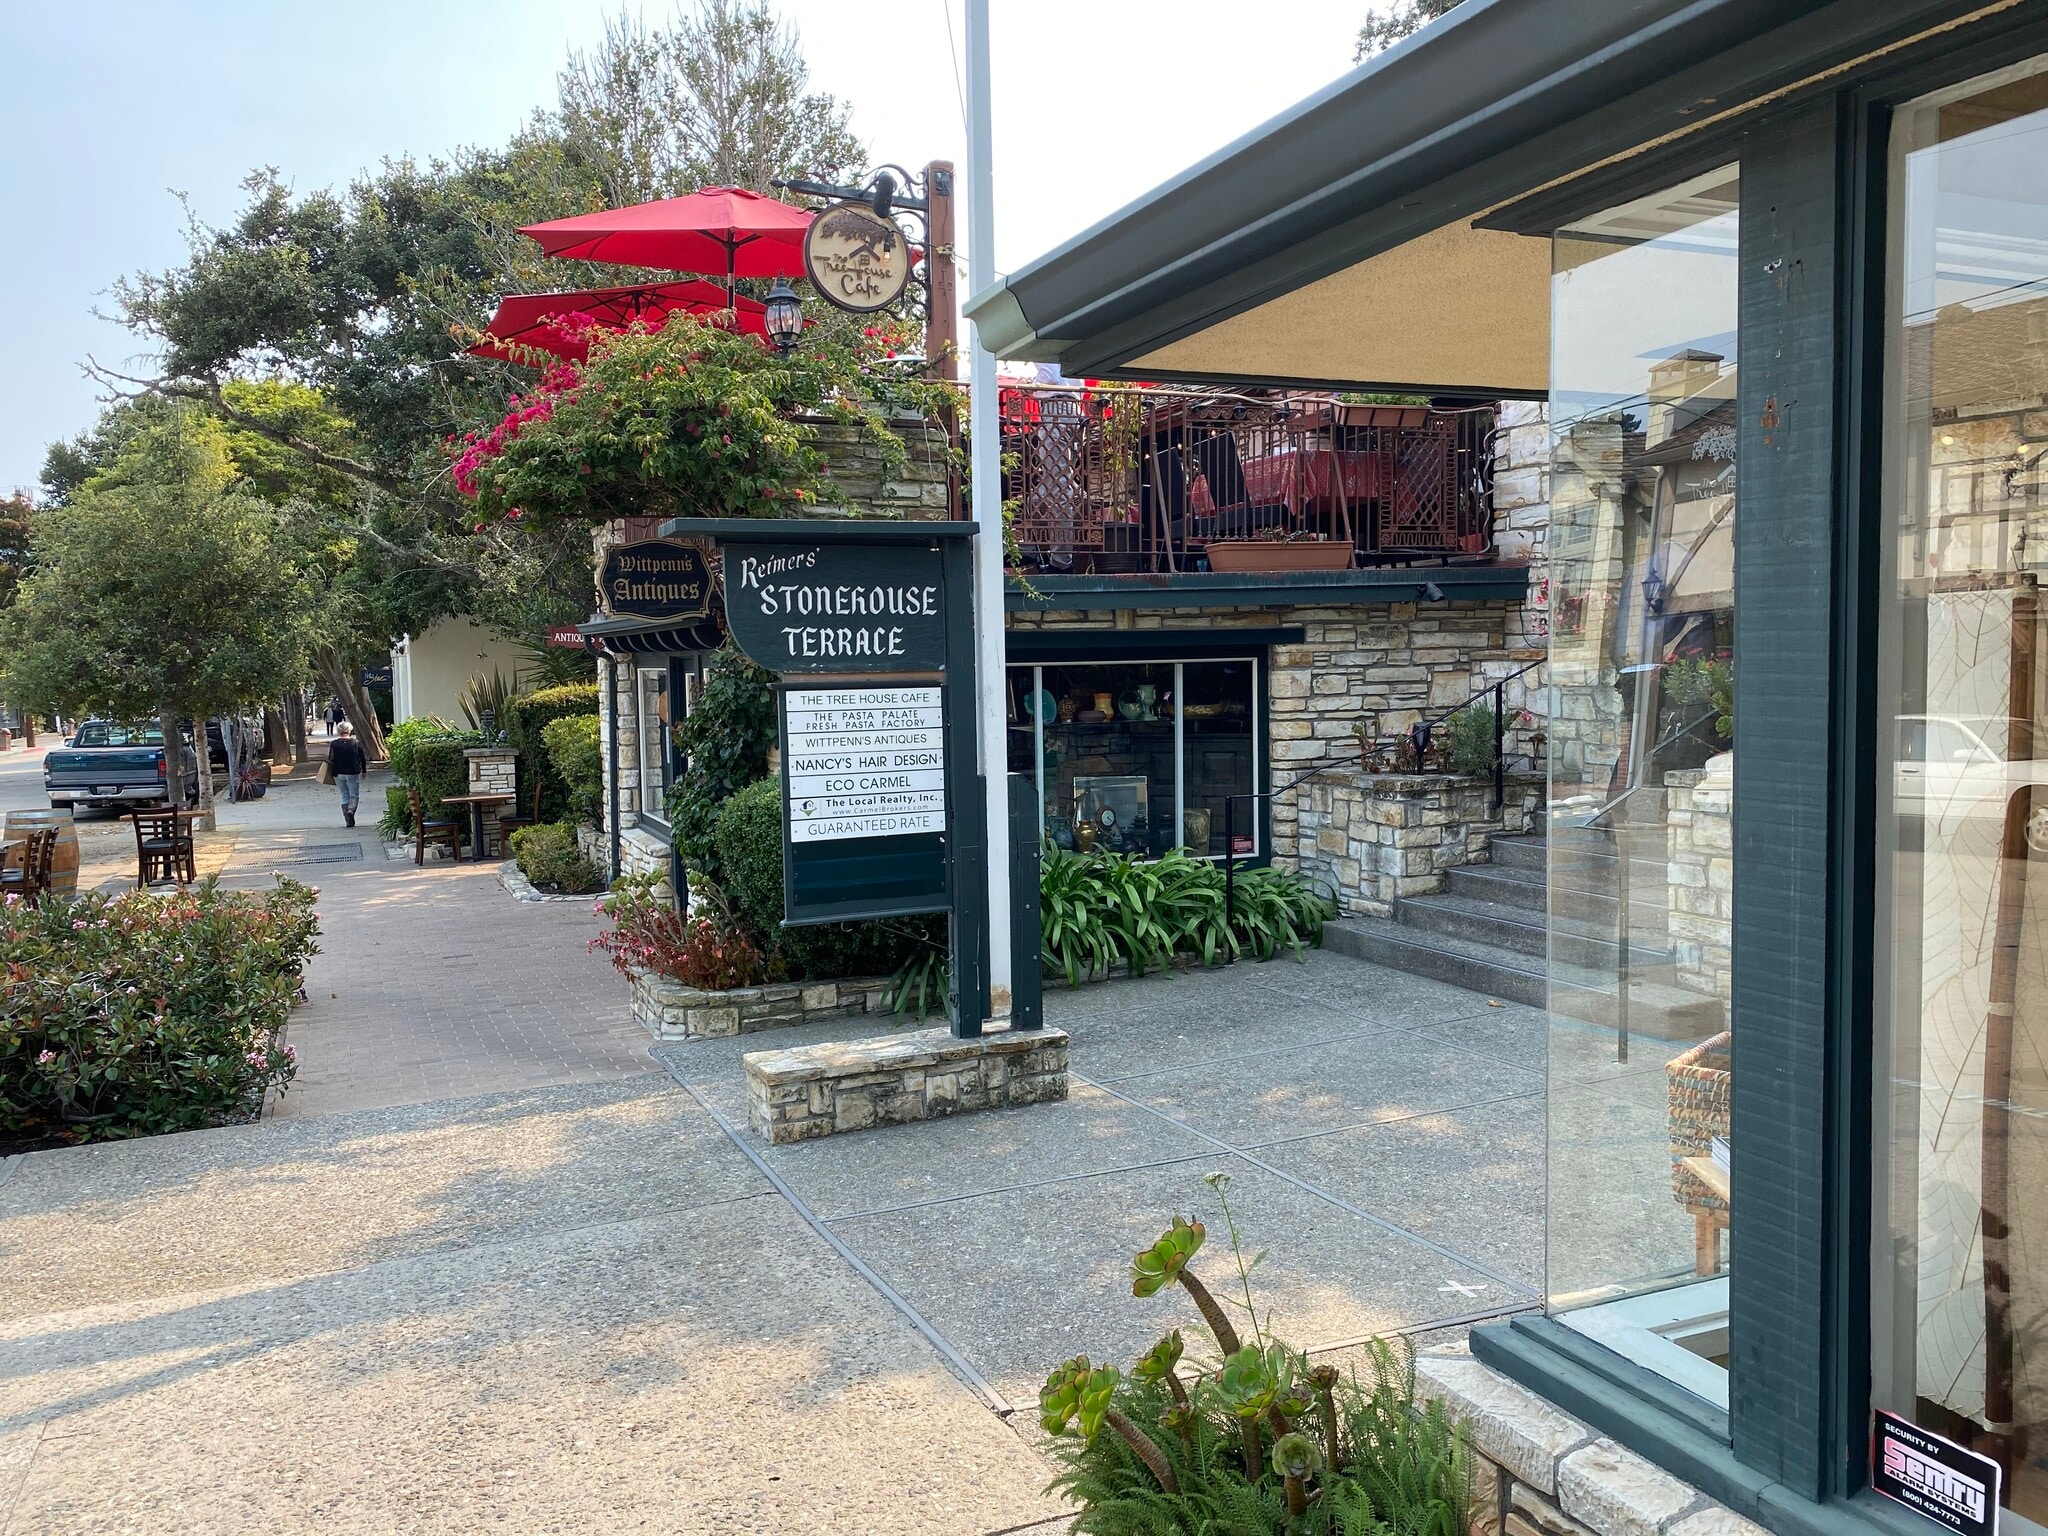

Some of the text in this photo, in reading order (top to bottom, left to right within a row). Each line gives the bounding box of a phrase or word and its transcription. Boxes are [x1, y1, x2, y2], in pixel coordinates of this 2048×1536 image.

[841, 274, 882, 300] Cafe
[617, 554, 693, 575] Wittpenn's
[740, 547, 821, 589] Reimers'
[613, 577, 700, 604] Antiques
[760, 584, 938, 616] STONEHOUSE
[554, 633, 595, 643] ANTIQUS
[780, 626, 906, 657] TERRACE
[800, 692, 930, 705] THE TREE HOUSE CAFE
[806, 719, 925, 731] FRESH PASTA FACTORY
[814, 710, 918, 721] THE PASTA PALATE
[805, 734, 927, 748] WITTPENN'S ANTIQUES
[795, 754, 938, 771] NANCY'S HAIR DESIGN
[826, 776, 911, 791] ECO CARMEL
[826, 793, 938, 808] The Local Realty, Inc.
[832, 804, 929, 816] www.CarmelBrokers.com
[808, 816, 930, 836] GUARANTEED RATE
[1885, 1423, 1940, 1455] SECURITY BY
[1889, 1469, 1977, 1519] ALARM SYSTEMS
[1902, 1488, 1961, 1525] (800) 424-7773
